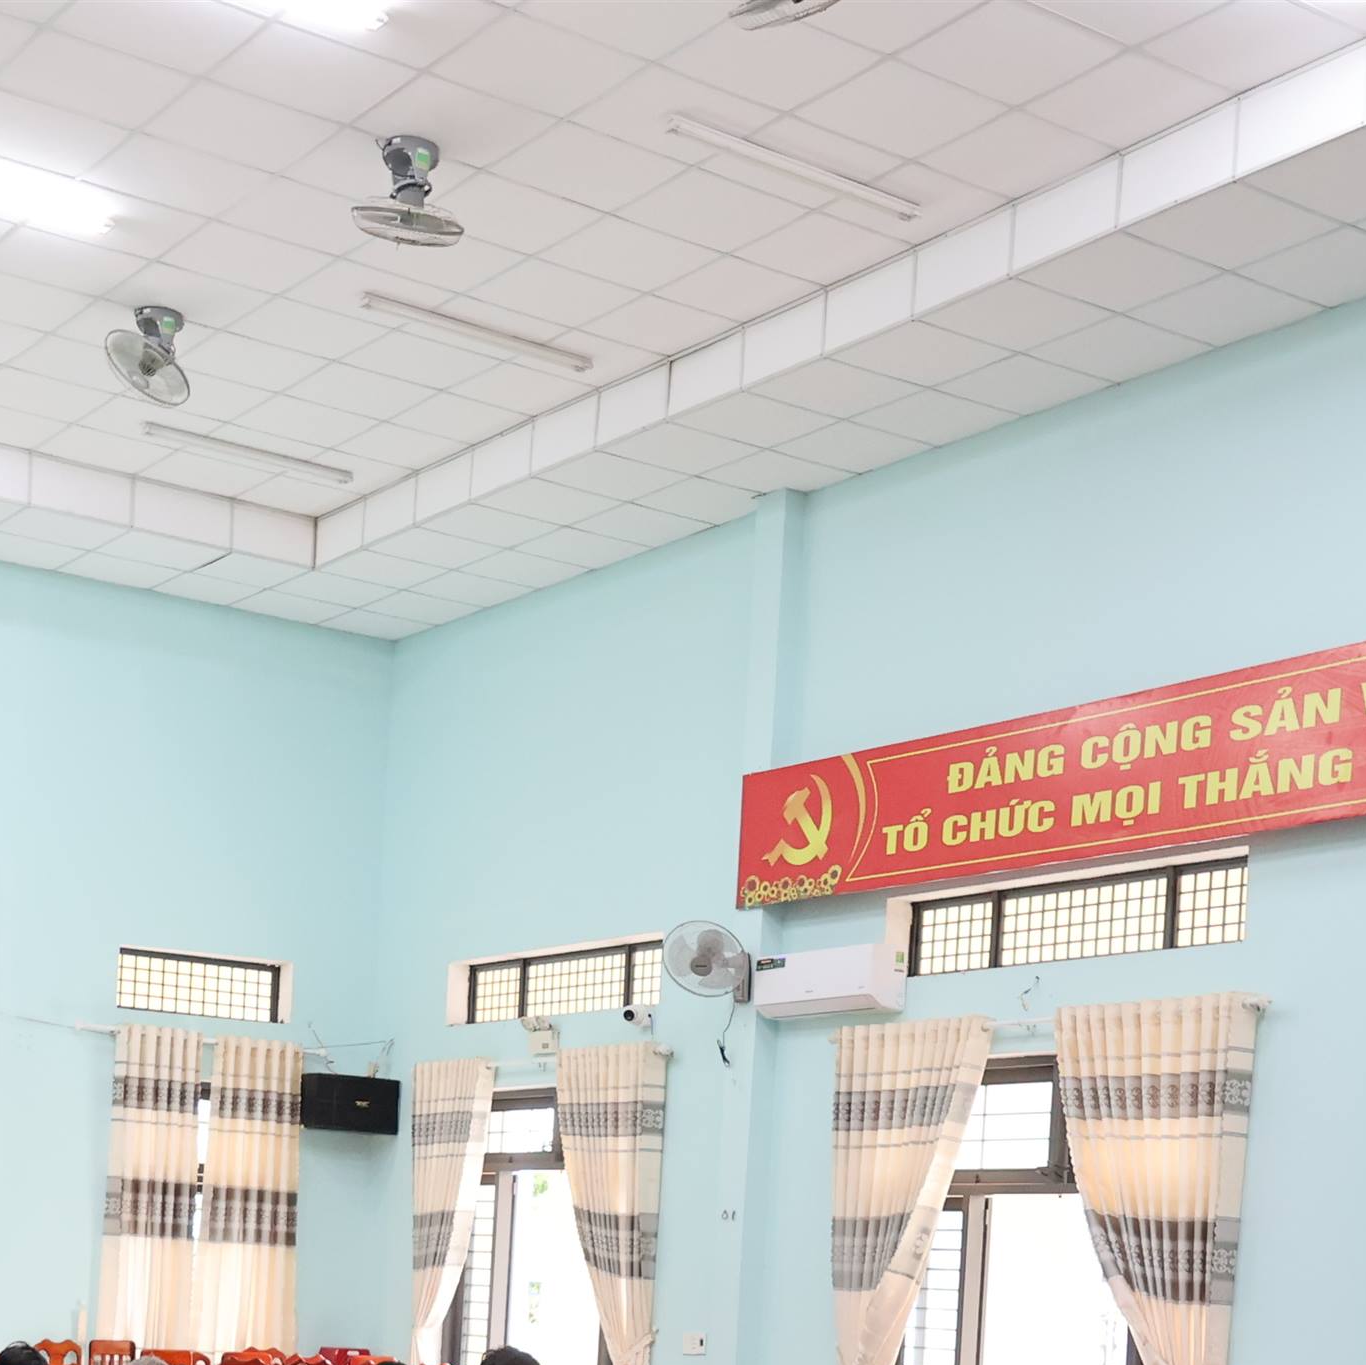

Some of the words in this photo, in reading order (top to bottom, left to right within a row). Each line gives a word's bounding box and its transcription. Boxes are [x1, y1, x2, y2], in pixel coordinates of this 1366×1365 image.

[947, 746, 1065, 794] ĐẢNG
[1080, 715, 1212, 769] CỘNG
[1229, 686, 1342, 742] SẢN
[882, 807, 932, 856] TỔ
[941, 798, 1055, 846] CHỨC
[1070, 780, 1162, 827] MỌI
[1178, 748, 1354, 810] THẮNG
